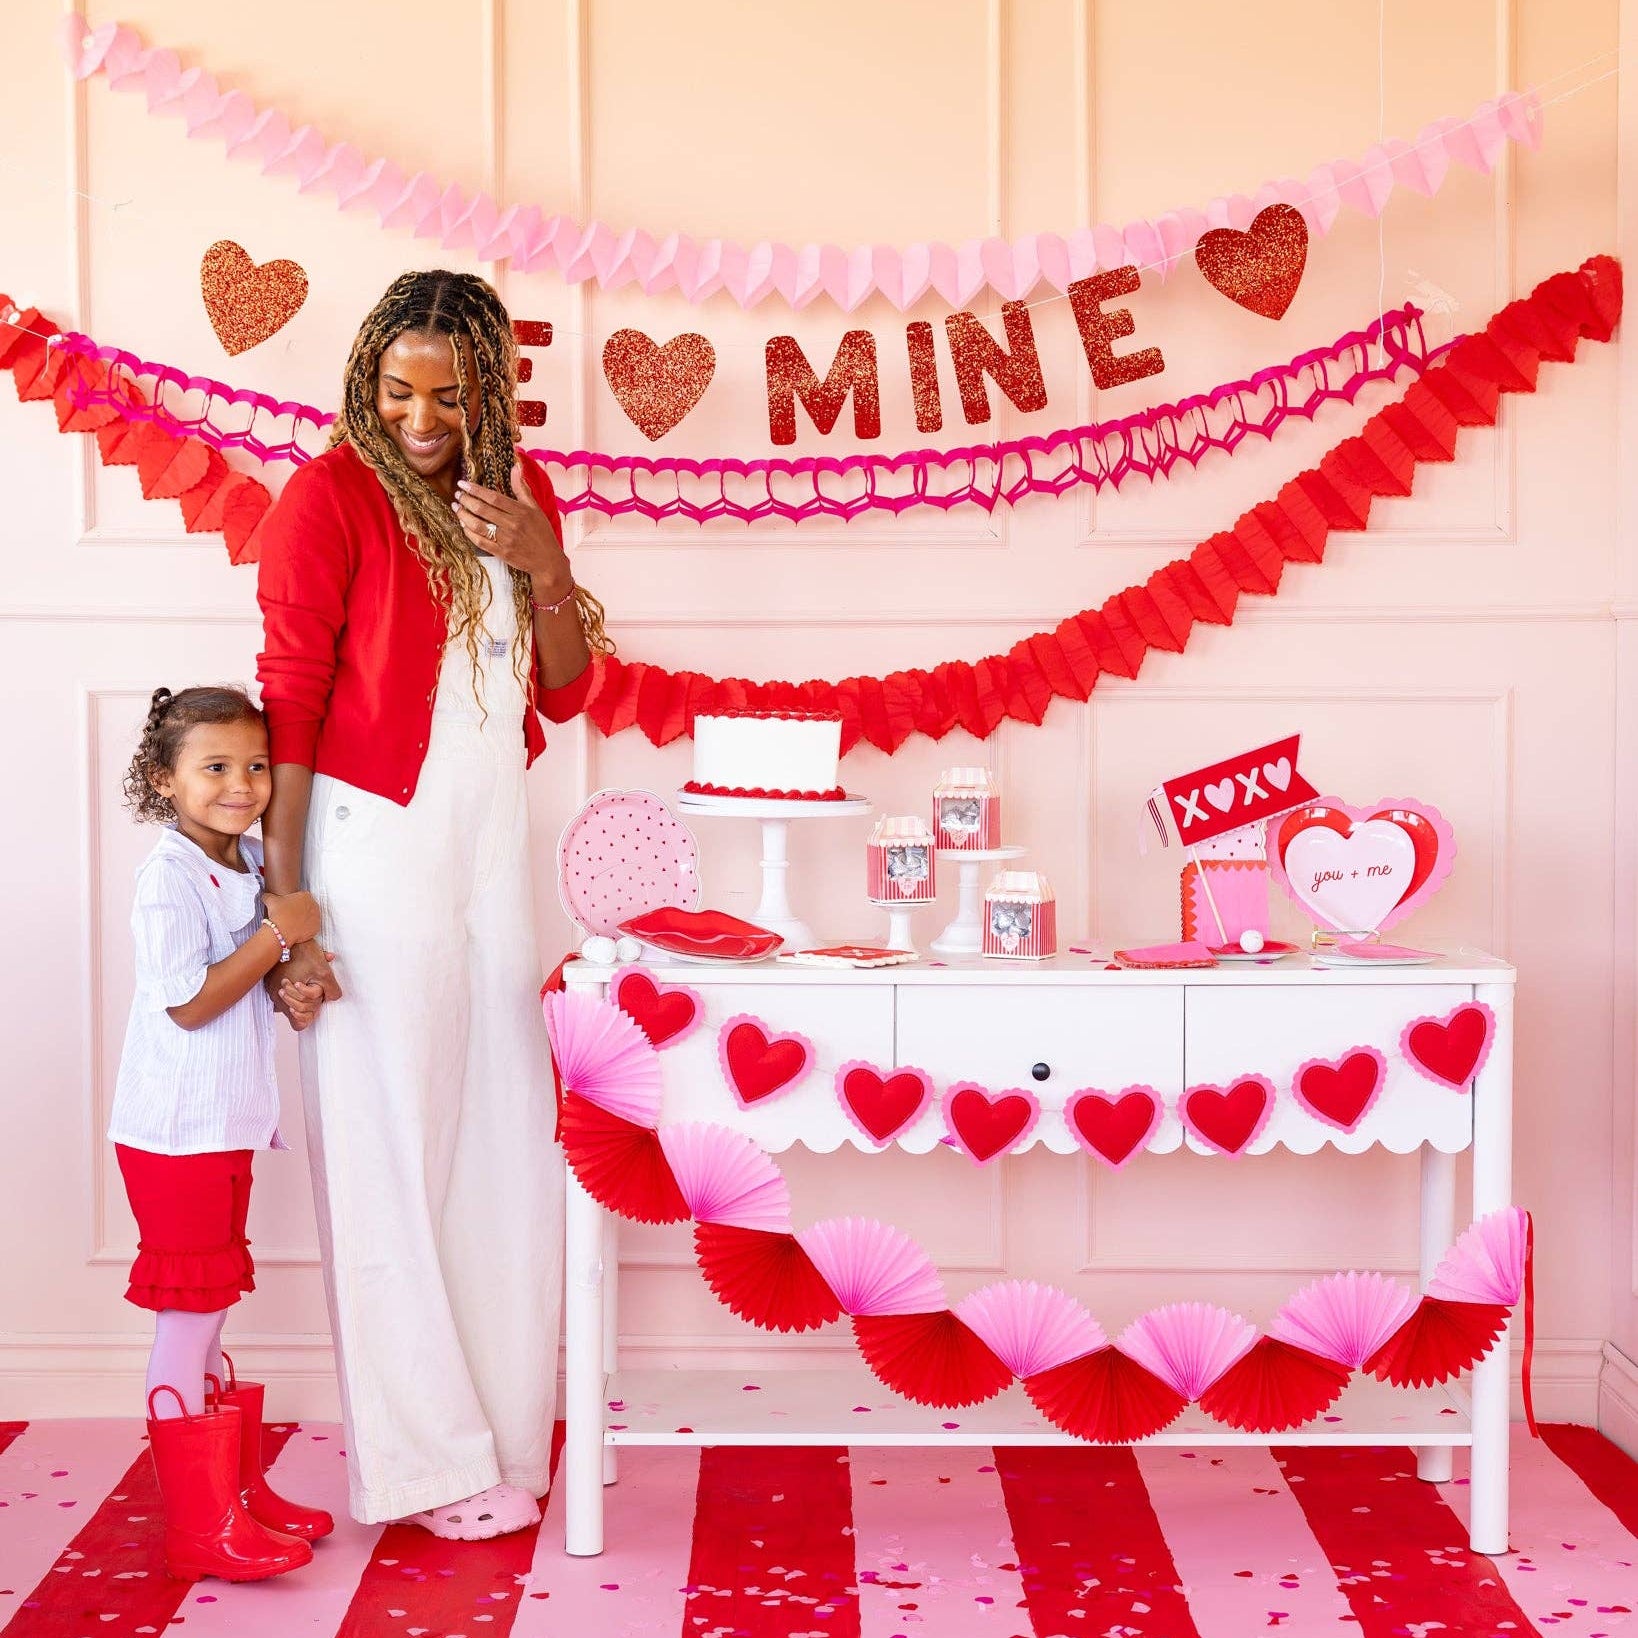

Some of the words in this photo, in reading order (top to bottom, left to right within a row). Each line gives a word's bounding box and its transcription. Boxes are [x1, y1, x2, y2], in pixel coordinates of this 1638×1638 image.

[765, 264, 1165, 445] MINE
[1311, 870, 1344, 893] you
[1367, 865, 1393, 877] me
